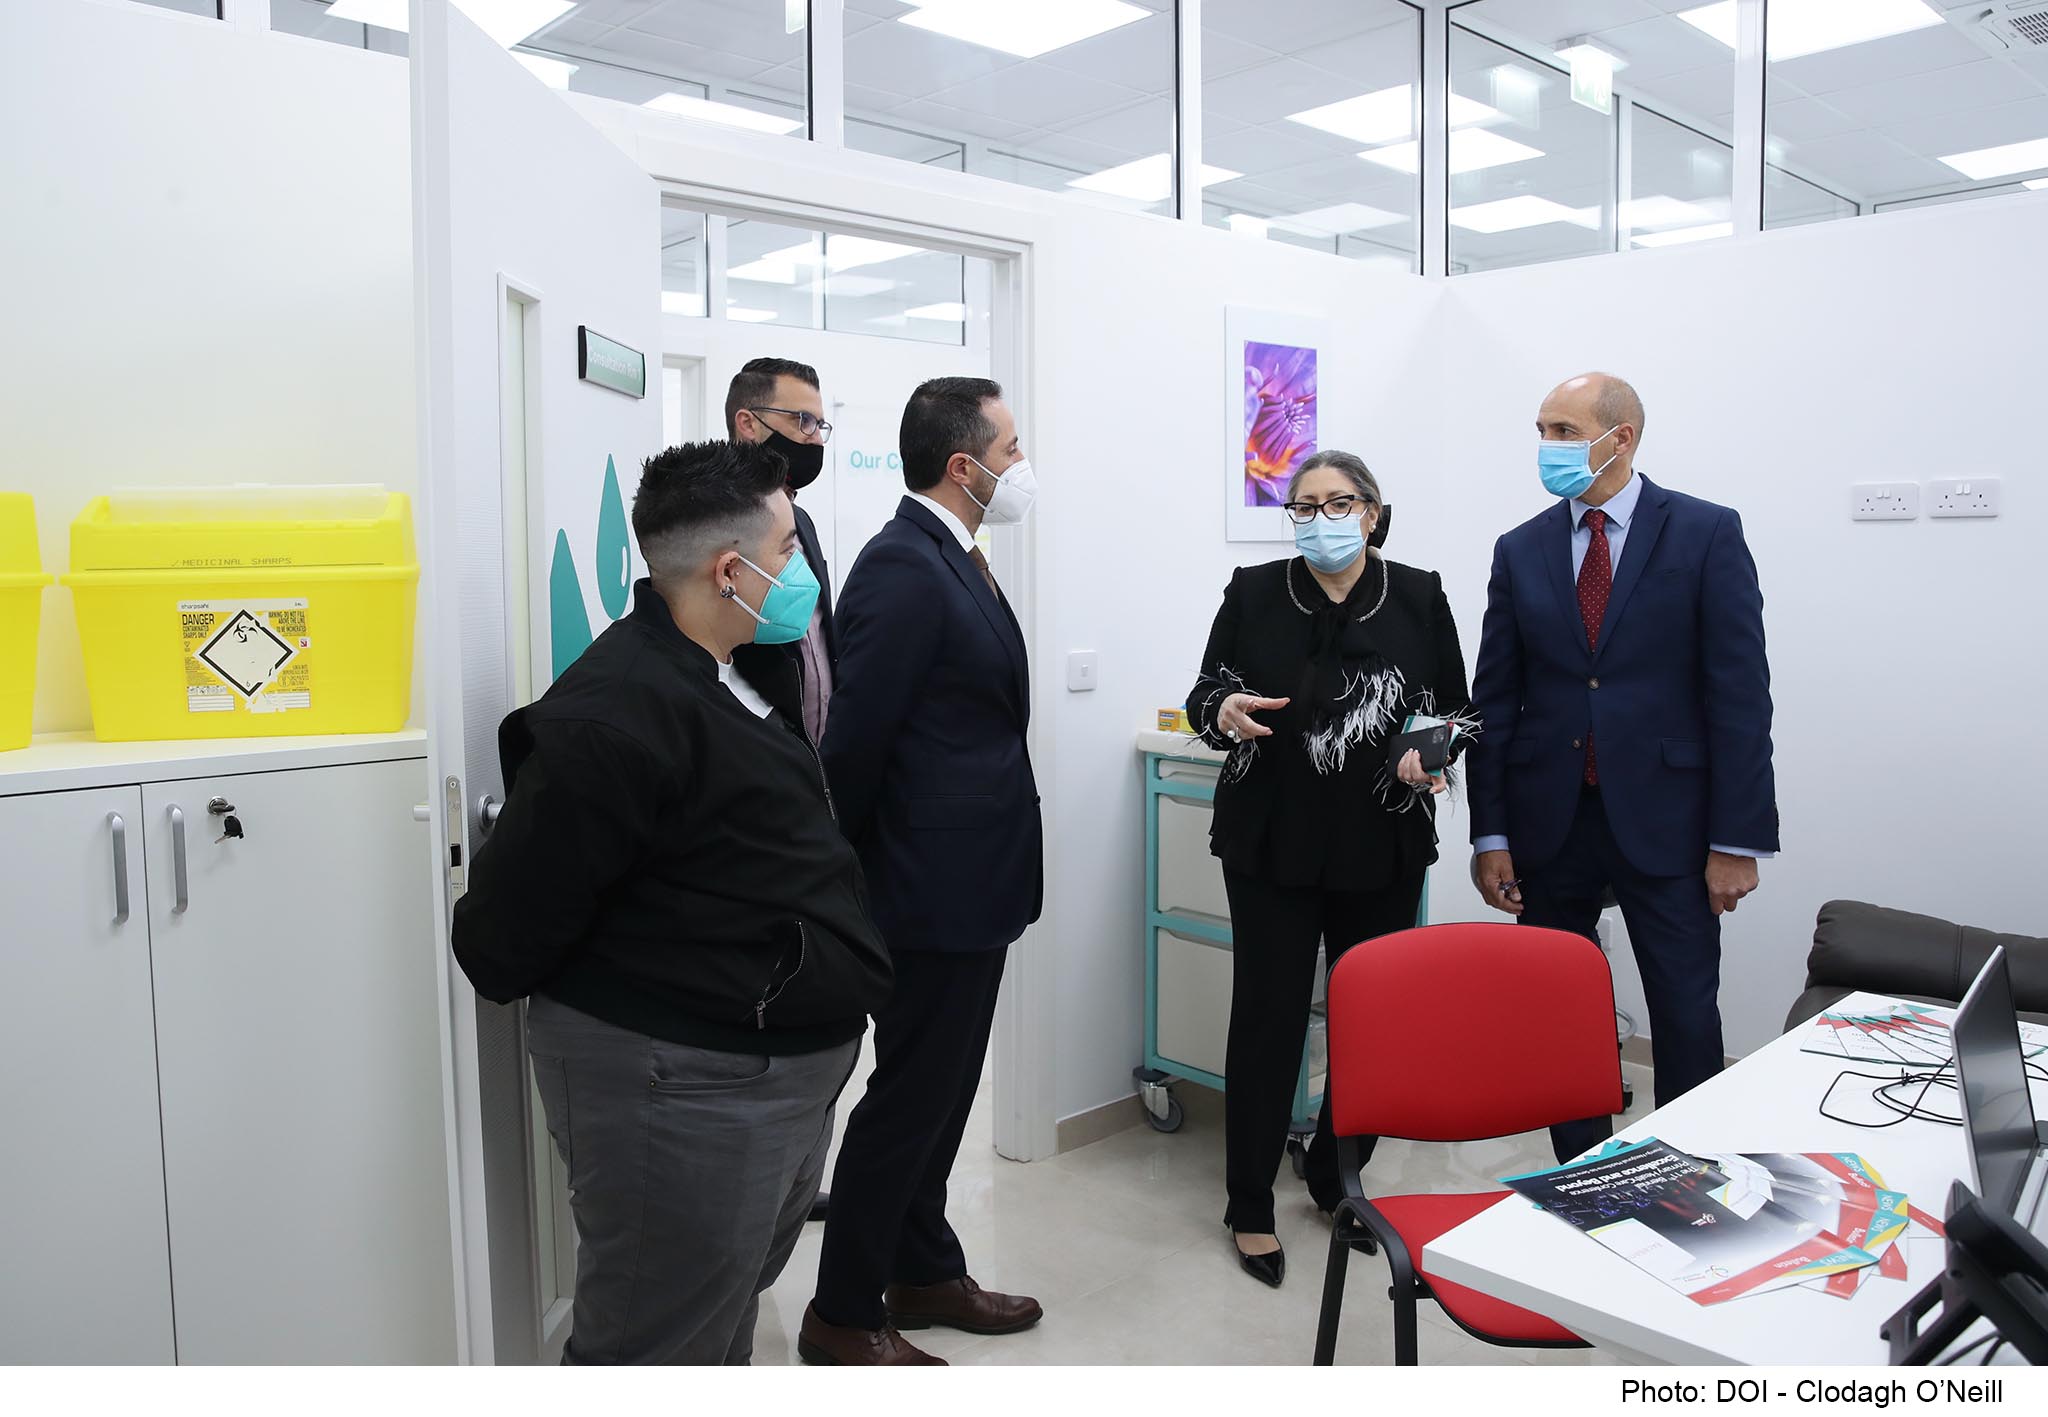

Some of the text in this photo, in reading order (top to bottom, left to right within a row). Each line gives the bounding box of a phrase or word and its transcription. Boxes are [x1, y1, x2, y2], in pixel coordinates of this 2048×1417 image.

[850, 450, 904, 470] Our C
[182, 557, 292, 567] MEDICINAL SHARPS
[182, 613, 215, 626] DANGER
[1657, 1160, 1689, 1176] Primary
[1682, 1166, 1700, 1175] The
[1841, 1156, 1865, 1172] NEWS
[1554, 1154, 1680, 1193] Excellence and Beyond
[1568, 1182, 1616, 1196] Conference
[1881, 1194, 1894, 1212] NEWS
[1871, 1217, 1890, 1233] NEWS
[1773, 1256, 1812, 1269] Bulletin
[1820, 1254, 1851, 1266] NEWS
